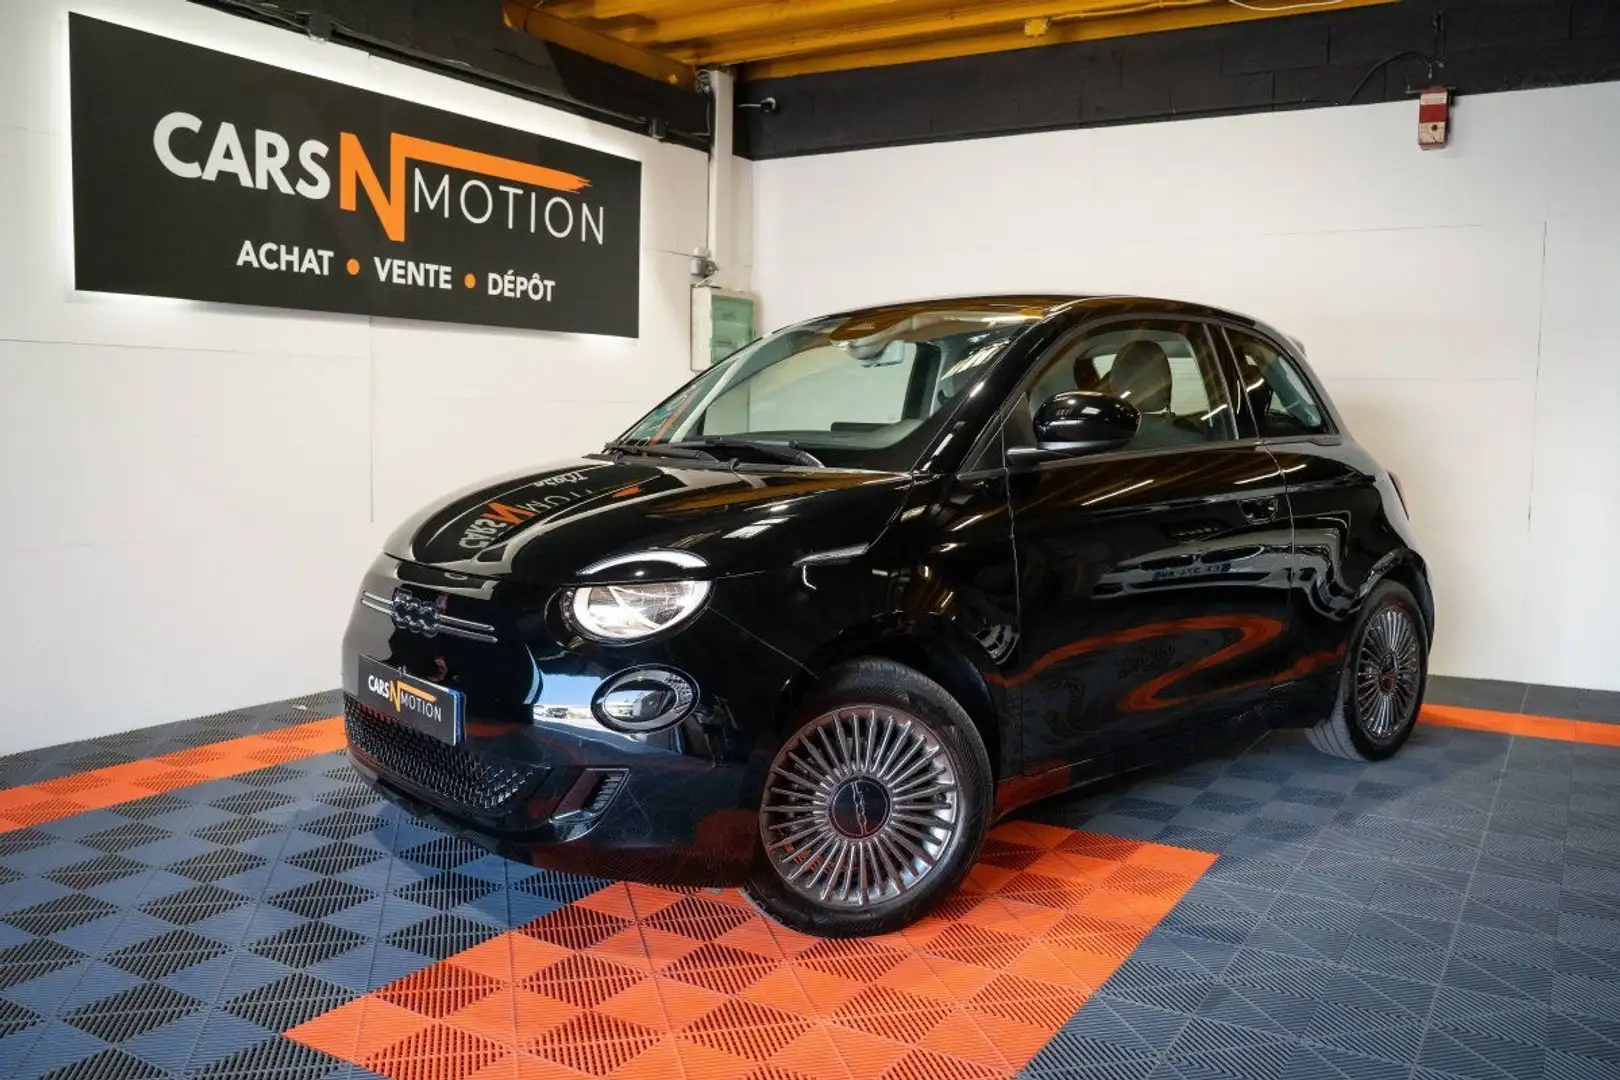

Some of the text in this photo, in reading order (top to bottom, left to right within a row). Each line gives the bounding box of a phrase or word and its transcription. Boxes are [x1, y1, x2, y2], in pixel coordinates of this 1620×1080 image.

[236, 240, 556, 302] ACHAT VENTE DÉPÔT
